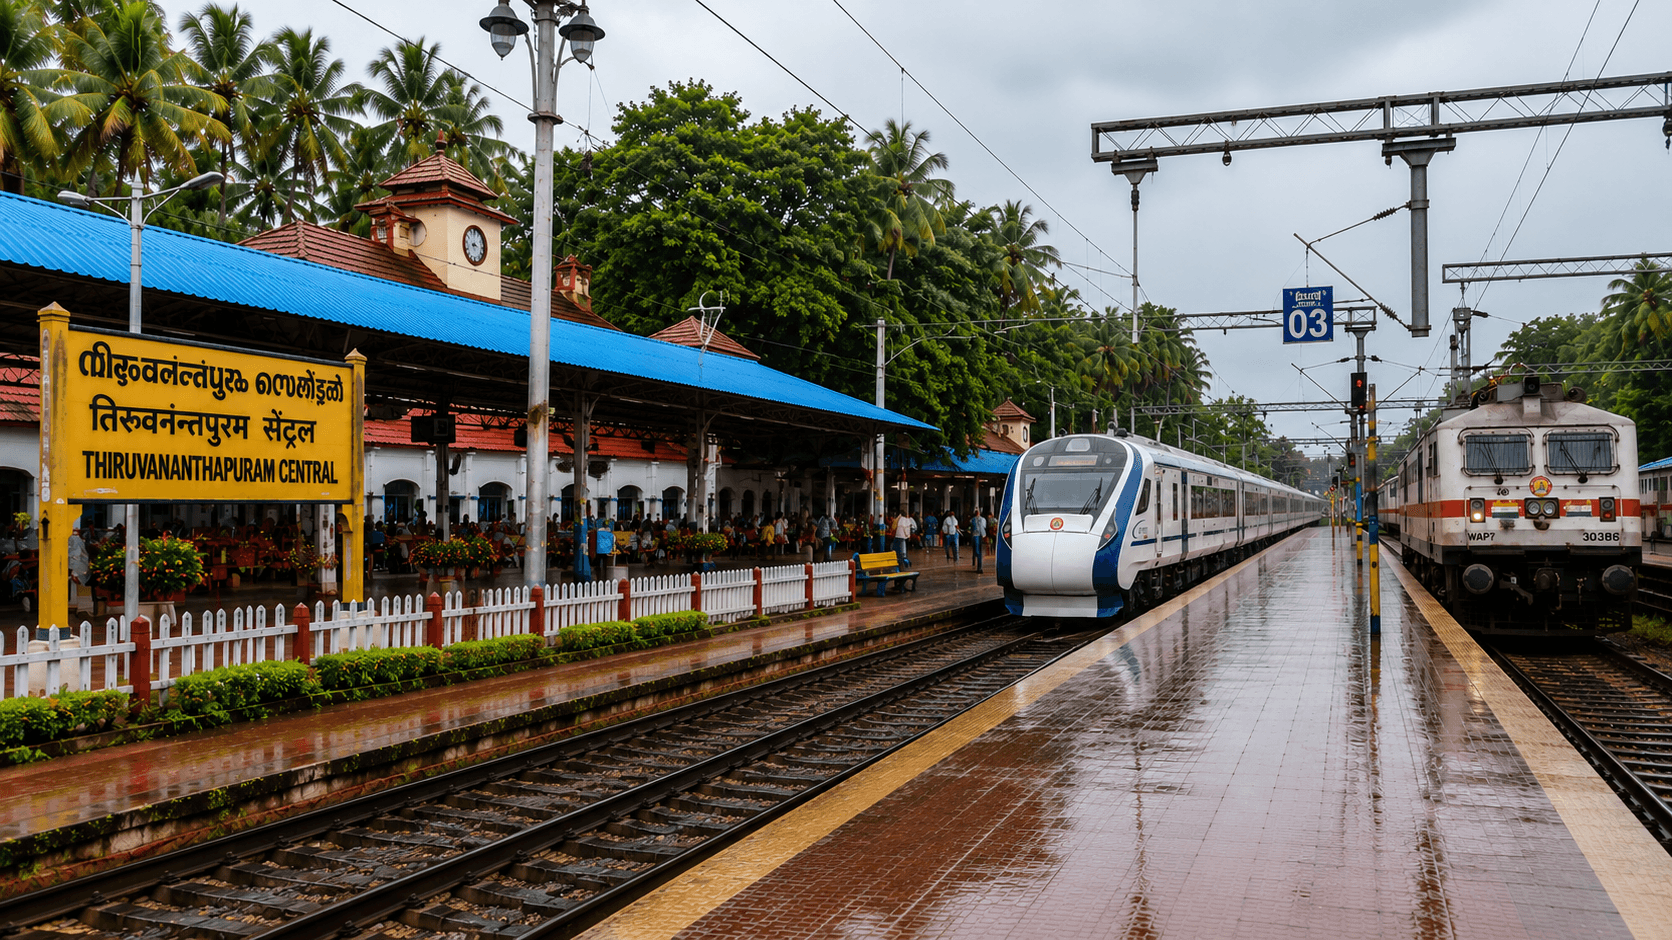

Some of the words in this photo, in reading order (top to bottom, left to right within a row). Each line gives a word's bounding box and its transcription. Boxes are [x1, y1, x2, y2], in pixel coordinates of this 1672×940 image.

[1289, 308, 1328, 339] 03
[263, 409, 317, 449] सेंट्रल
[82, 450, 275, 483] THIRUVANANTHAPURAM
[278, 458, 338, 485] CENTRAL
[1467, 532, 1496, 542] WAP7
